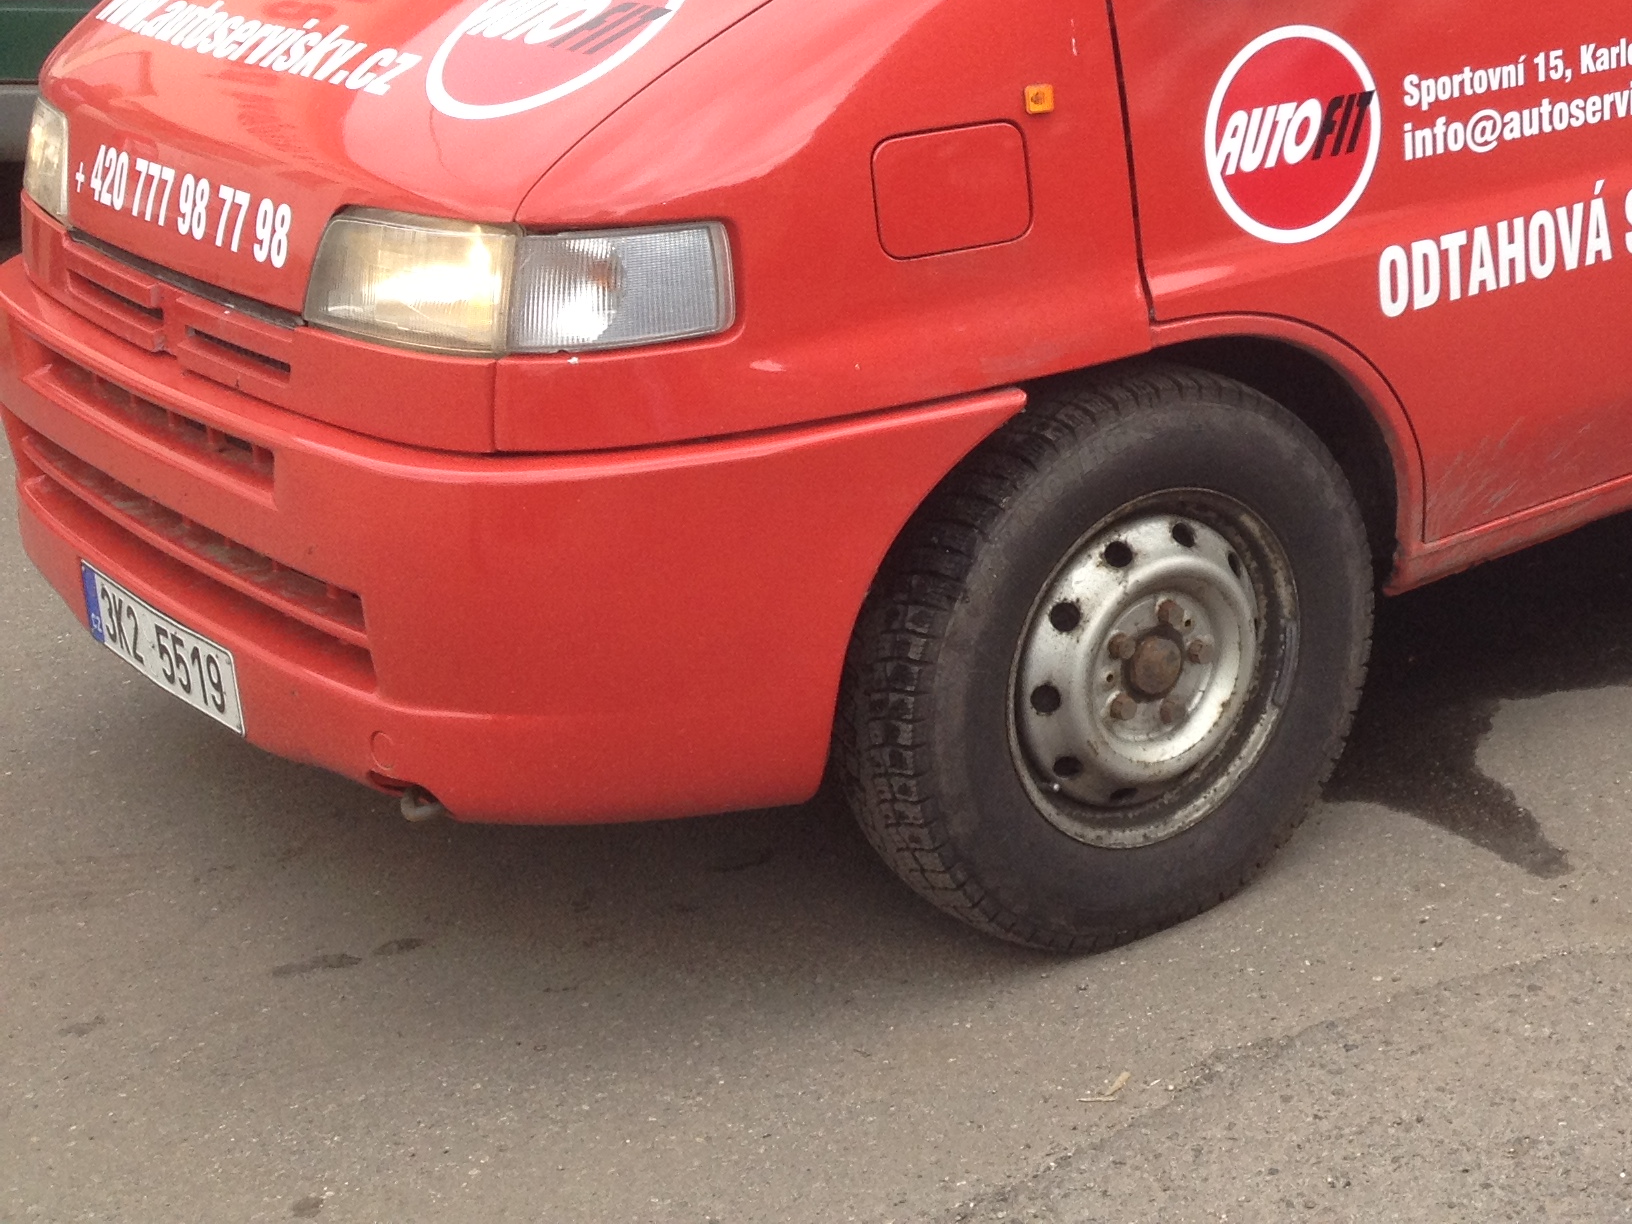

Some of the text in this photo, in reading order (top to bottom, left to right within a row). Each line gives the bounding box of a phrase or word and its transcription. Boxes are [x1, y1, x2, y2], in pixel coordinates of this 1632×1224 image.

[1216, 90, 1375, 176] AUTOFIT
[1403, 54, 1526, 110] Sportovní
[1533, 49, 1572, 84] 15,
[75, 144, 292, 268] + 420 777 98 77 98
[1378, 178, 1612, 318] ODTAHOVÁ
[101, 584, 144, 666] 3K2
[154, 623, 226, 714] 5519
